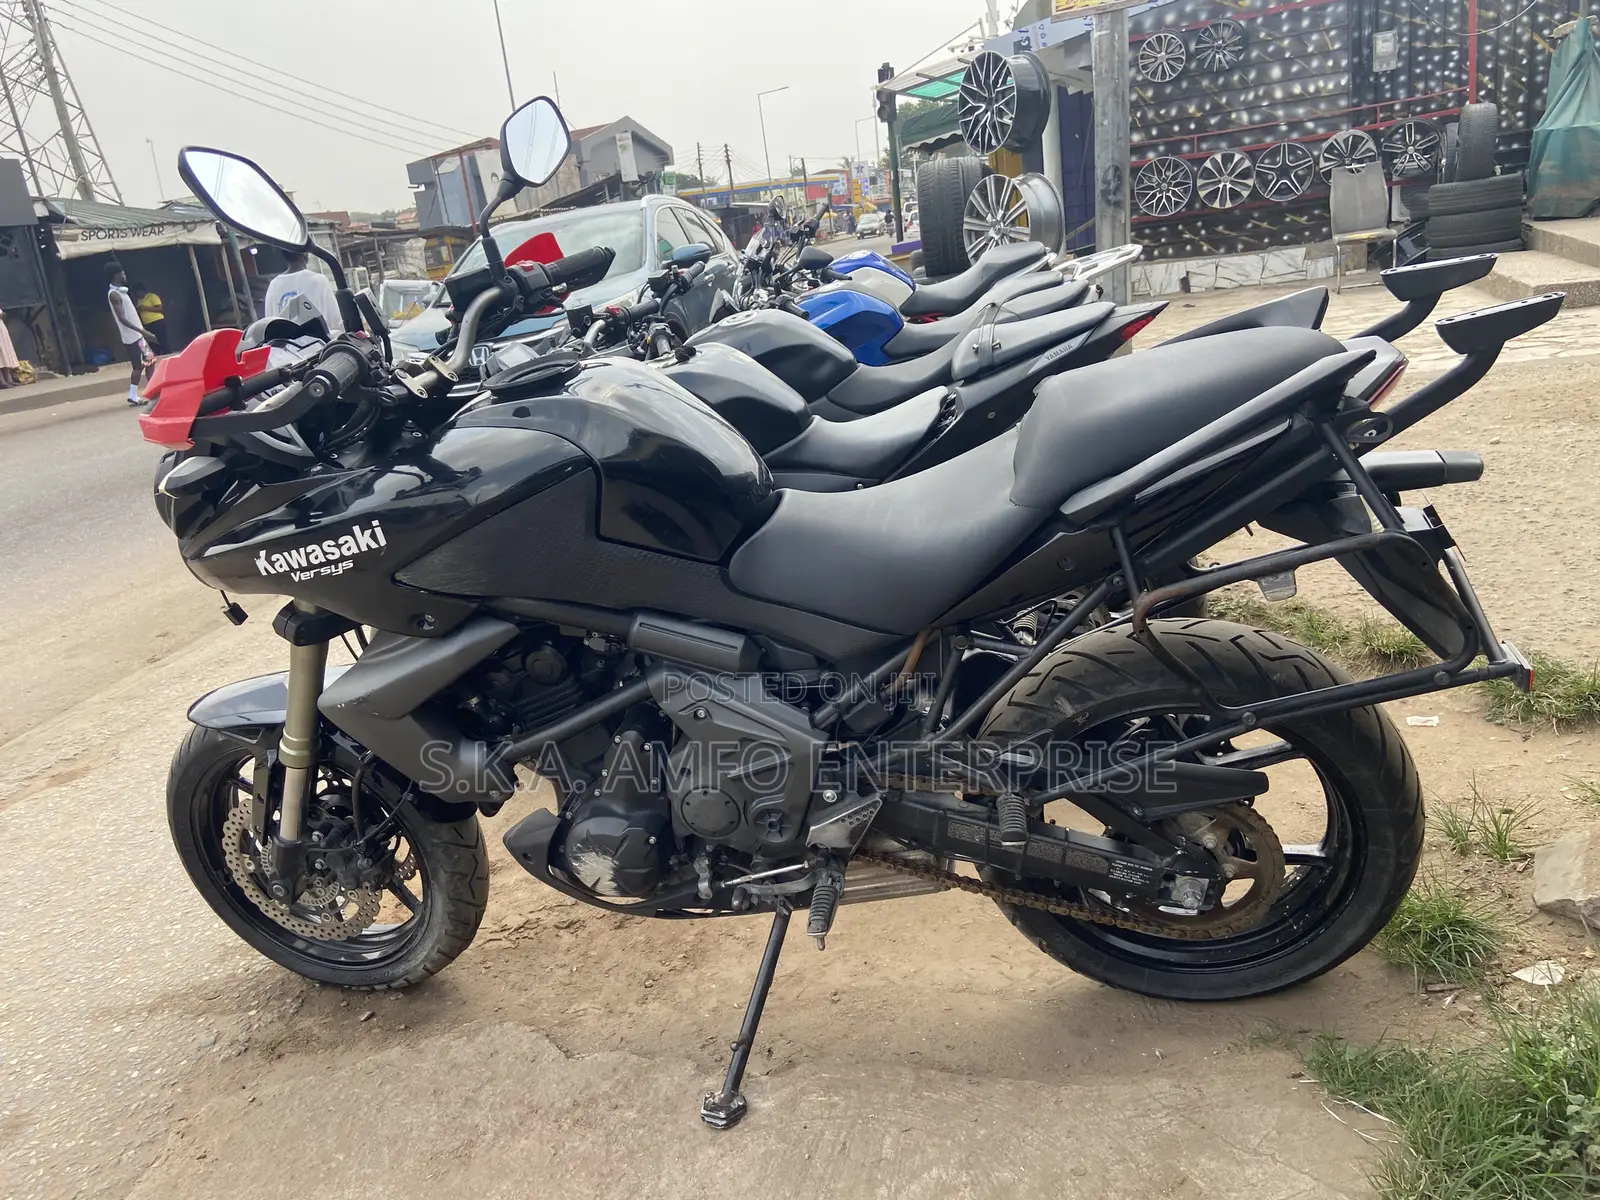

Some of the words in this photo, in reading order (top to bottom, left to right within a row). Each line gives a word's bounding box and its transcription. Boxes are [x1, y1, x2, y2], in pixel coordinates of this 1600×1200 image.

[80, 227, 128, 241] SPORTS
[131, 226, 165, 237] WEAR
[254, 519, 387, 576] Kawasaki
[290, 559, 354, 583] Versys
